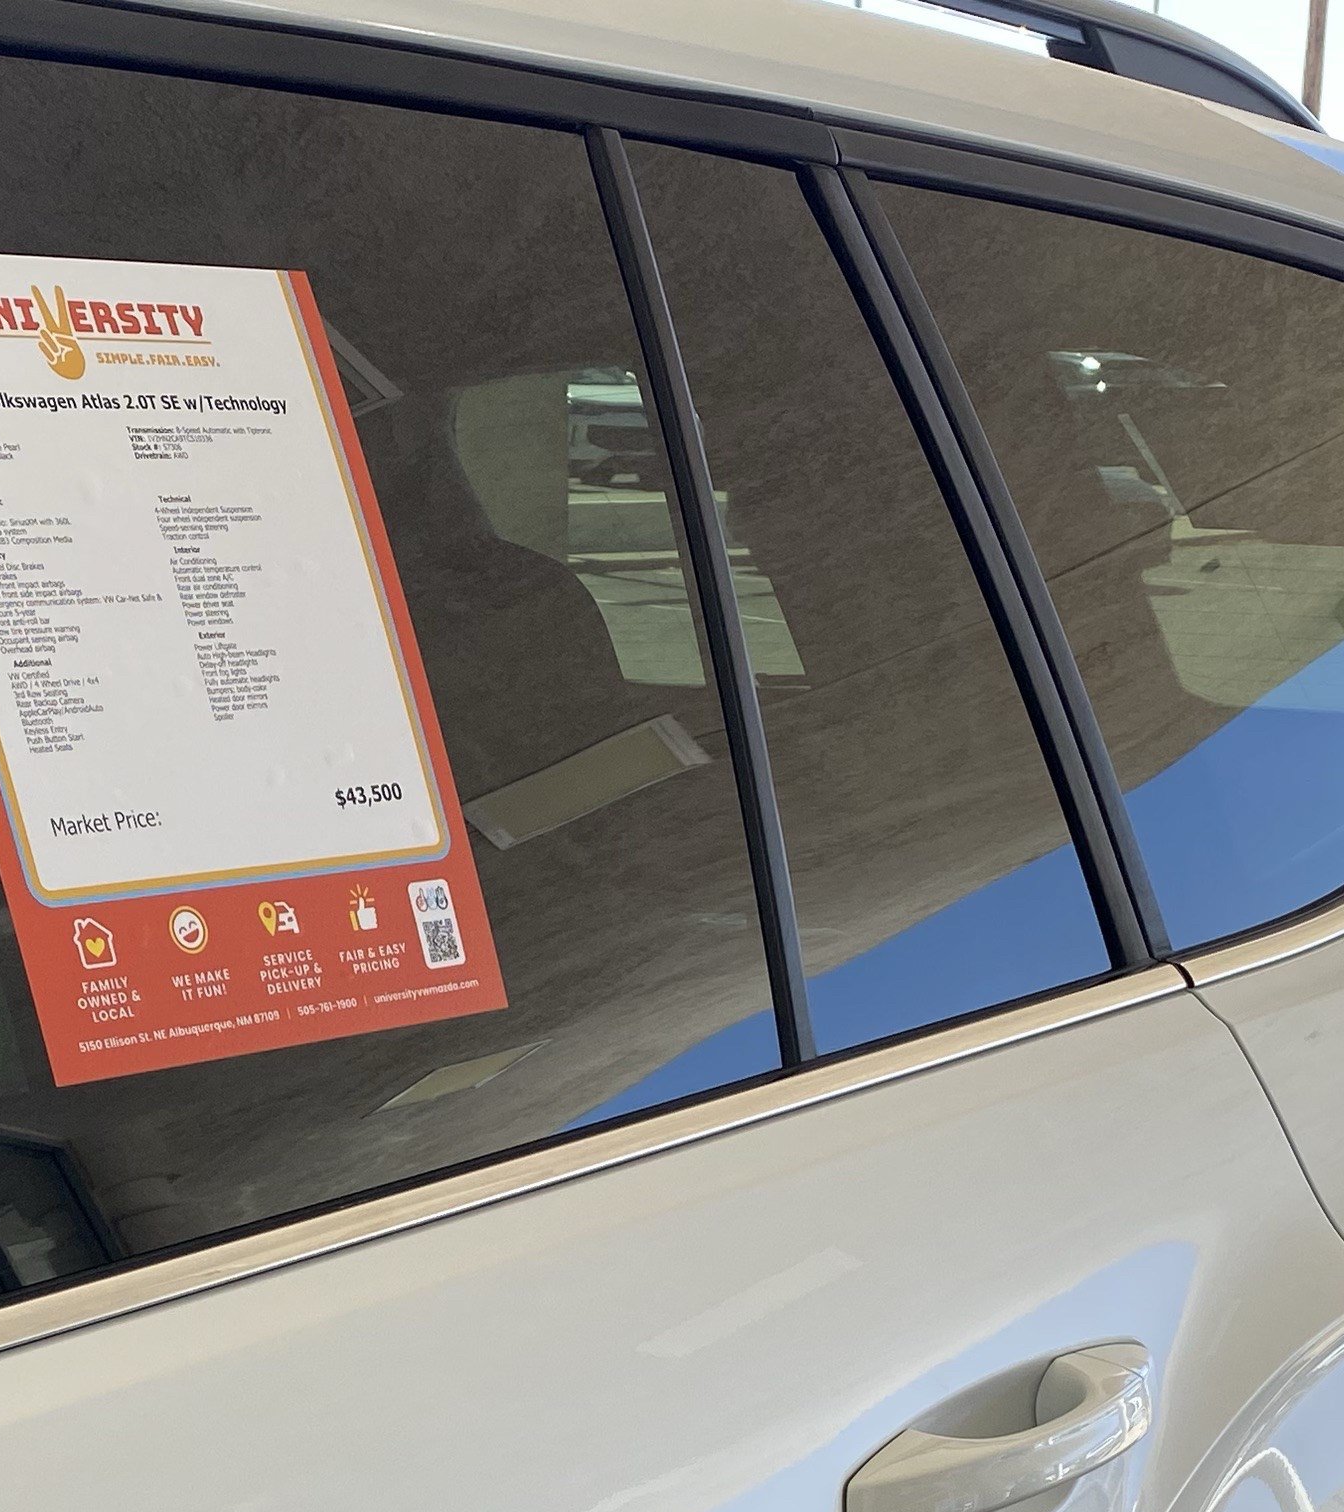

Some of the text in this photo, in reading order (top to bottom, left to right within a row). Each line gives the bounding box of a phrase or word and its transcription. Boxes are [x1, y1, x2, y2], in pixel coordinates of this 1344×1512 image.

[81, 393, 120, 409] Atlas
[122, 394, 155, 409] 2.0T
[160, 394, 181, 409] SE
[182, 394, 286, 414] w/Technology
[157, 494, 191, 503] Technical
[172, 545, 200, 553] Interior
[197, 631, 225, 639] Exterior
[13, 658, 52, 667] Additional
[334, 782, 402, 809] $43,500
[50, 810, 161, 836] Market Price:
[263, 949, 312, 966] SERVICE
[338, 942, 405, 962] FAIR & EASY
[259, 962, 322, 981] PICK-UP &
[352, 957, 399, 974] PRICING
[81, 976, 127, 993] FAMILY
[171, 968, 230, 987] WE MAKE
[266, 976, 320, 994] DELIVERY
[77, 989, 140, 1009] OWNED &
[181, 983, 226, 1000] IT FUN!
[91, 1005, 134, 1022] LOCAL
[78, 1039, 102, 1052] 5150
[103, 1035, 137, 1048] Ellison
[138, 1032, 152, 1042] St.
[152, 1029, 167, 1040] NE
[168, 1020, 235, 1037] Albuquerque,
[235, 1014, 252, 1026] NM
[253, 1010, 279, 1023] 87109
[297, 997, 357, 1016] 505-761-1900
